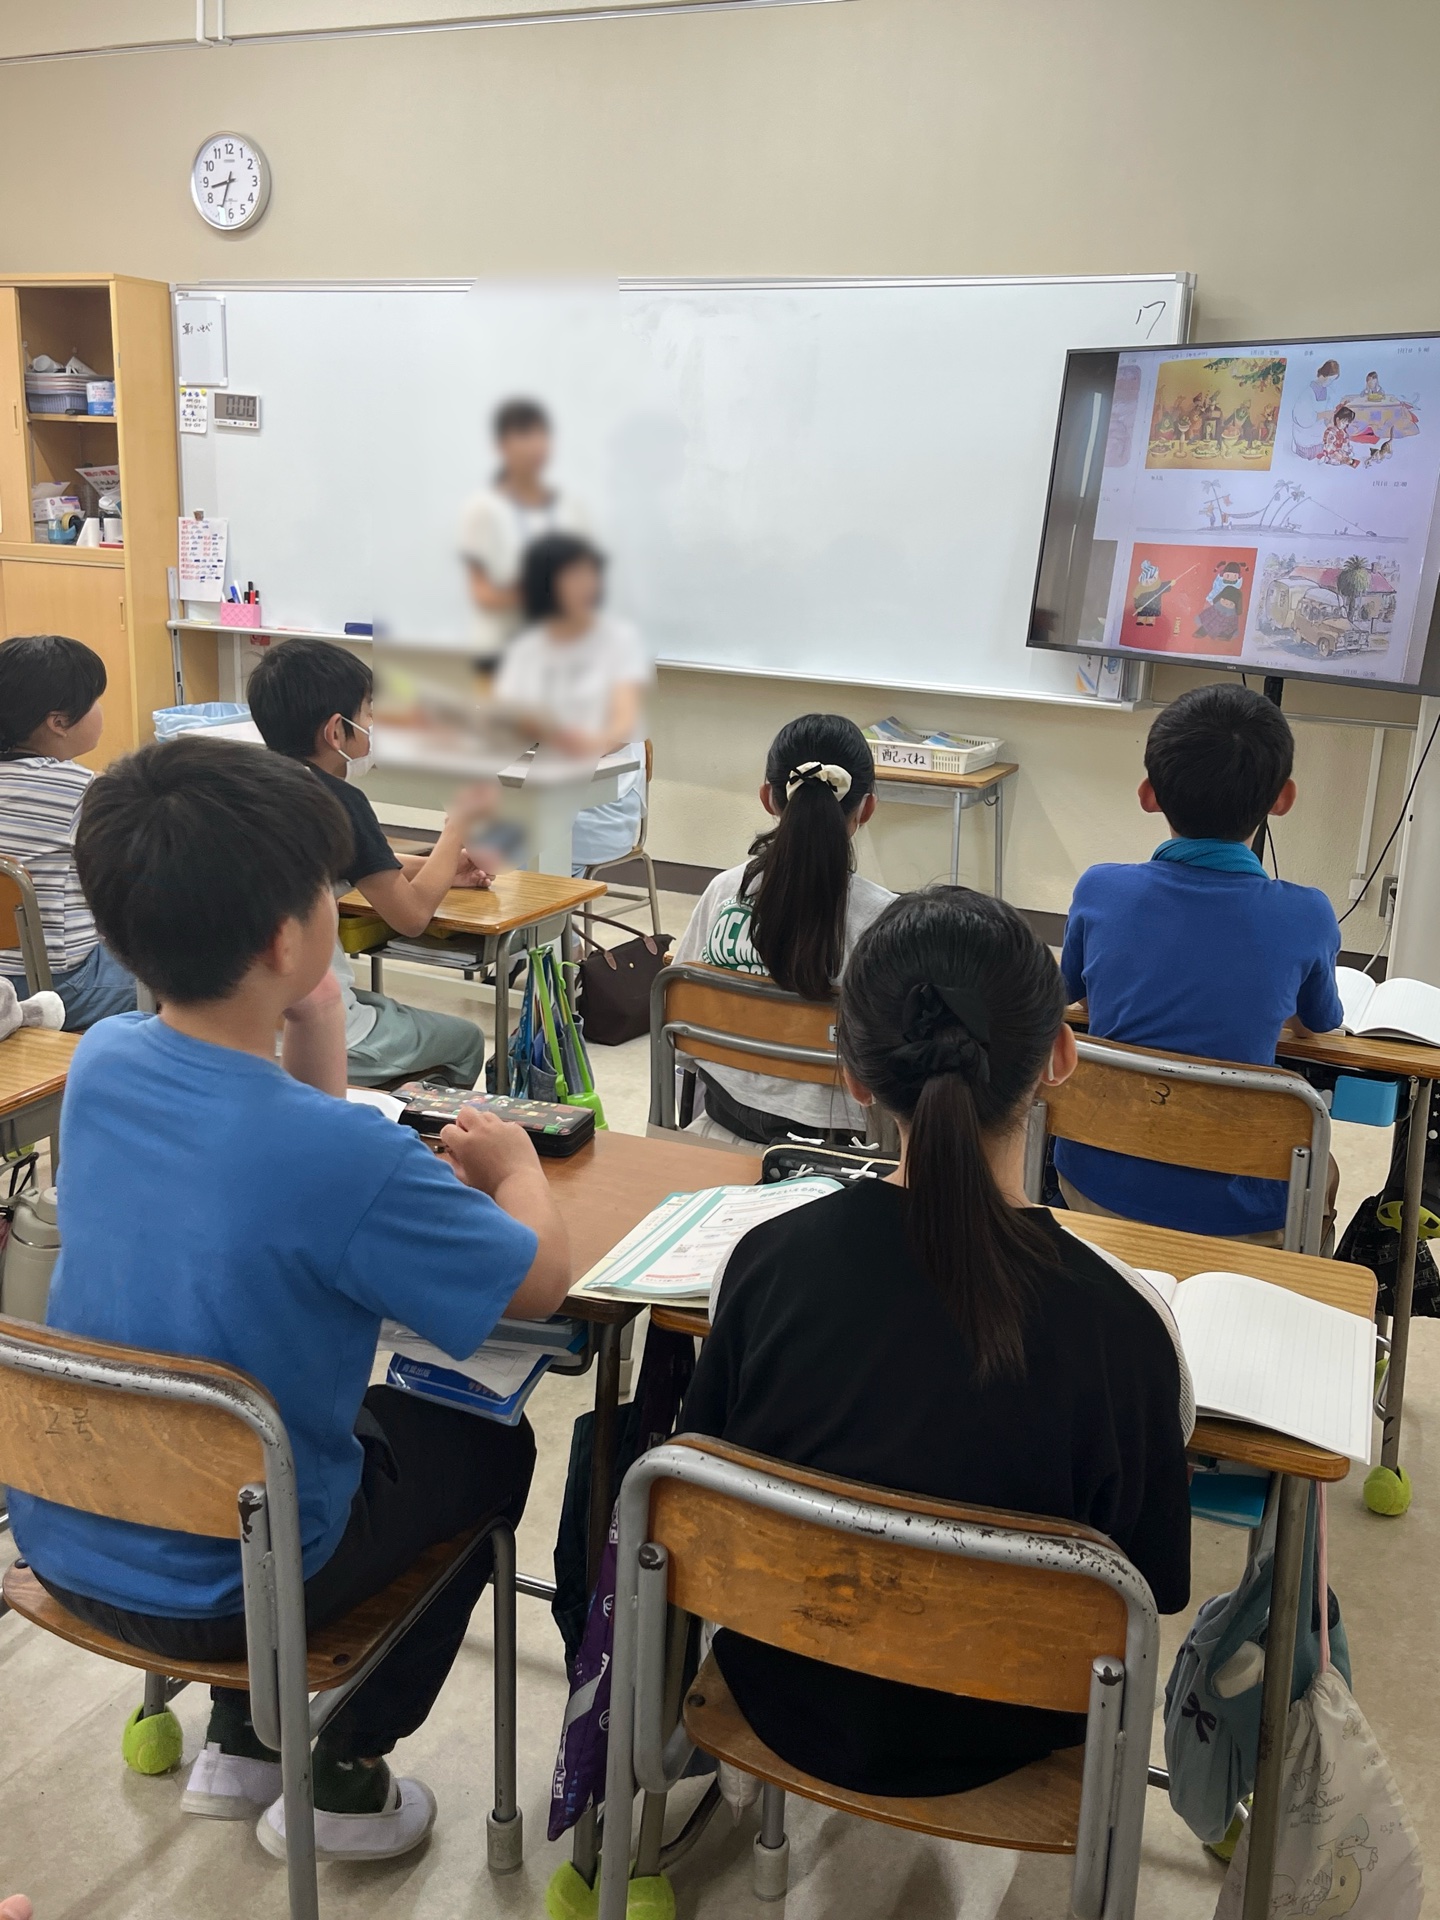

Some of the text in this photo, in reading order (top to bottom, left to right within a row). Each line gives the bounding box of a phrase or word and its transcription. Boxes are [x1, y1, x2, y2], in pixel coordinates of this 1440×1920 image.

[214, 148, 221, 159] 11
[225, 143, 234, 154] 12
[239, 147, 243, 158] 1
[205, 160, 214, 172] 10
[247, 158, 253, 170] 2
[203, 176, 209, 188] 9
[252, 175, 258, 187] 3
[207, 192, 213, 204] 8
[247, 192, 254, 203] 4
[228, 208, 234, 219] 6
[240, 204, 246, 215] 5
[882, 749, 926, 765] 配ってね
